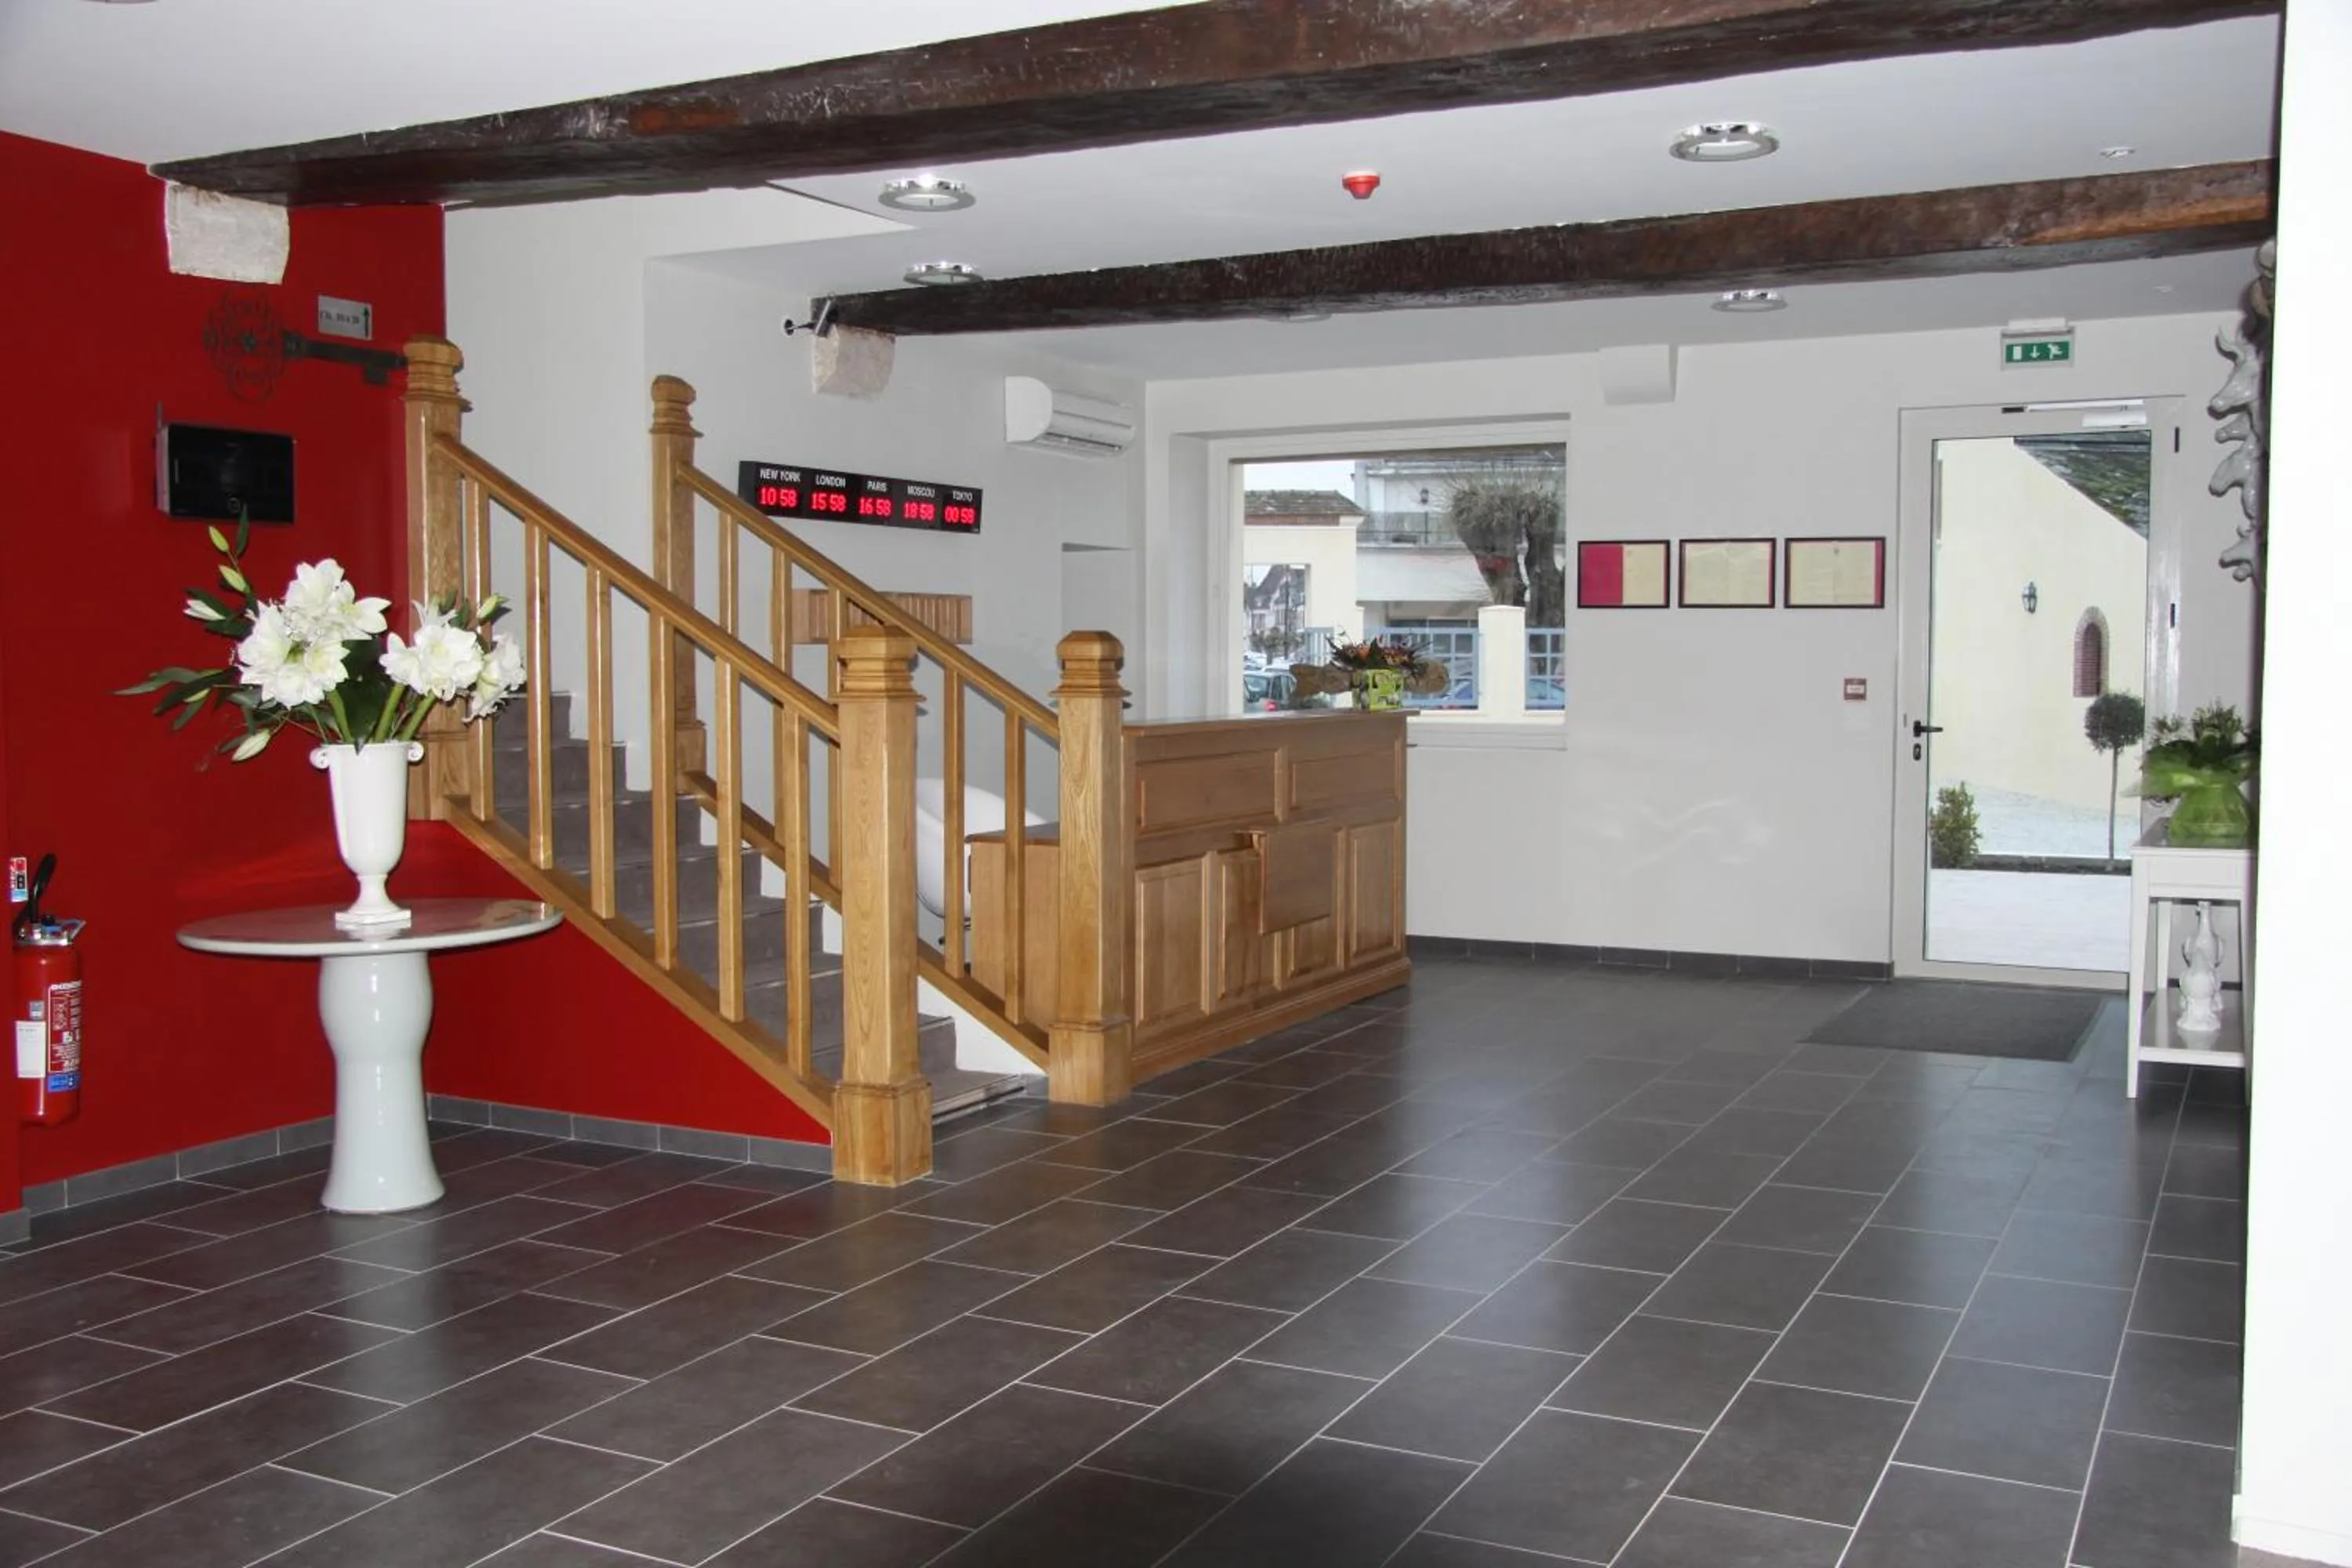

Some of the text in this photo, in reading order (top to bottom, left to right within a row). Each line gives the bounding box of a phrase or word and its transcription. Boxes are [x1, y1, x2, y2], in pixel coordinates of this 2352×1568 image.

[760, 468, 800, 482] NEW YORK
[816, 475, 846, 487] LONDON
[866, 481, 887, 492] PARIS
[907, 485, 935, 498] MOSCOU
